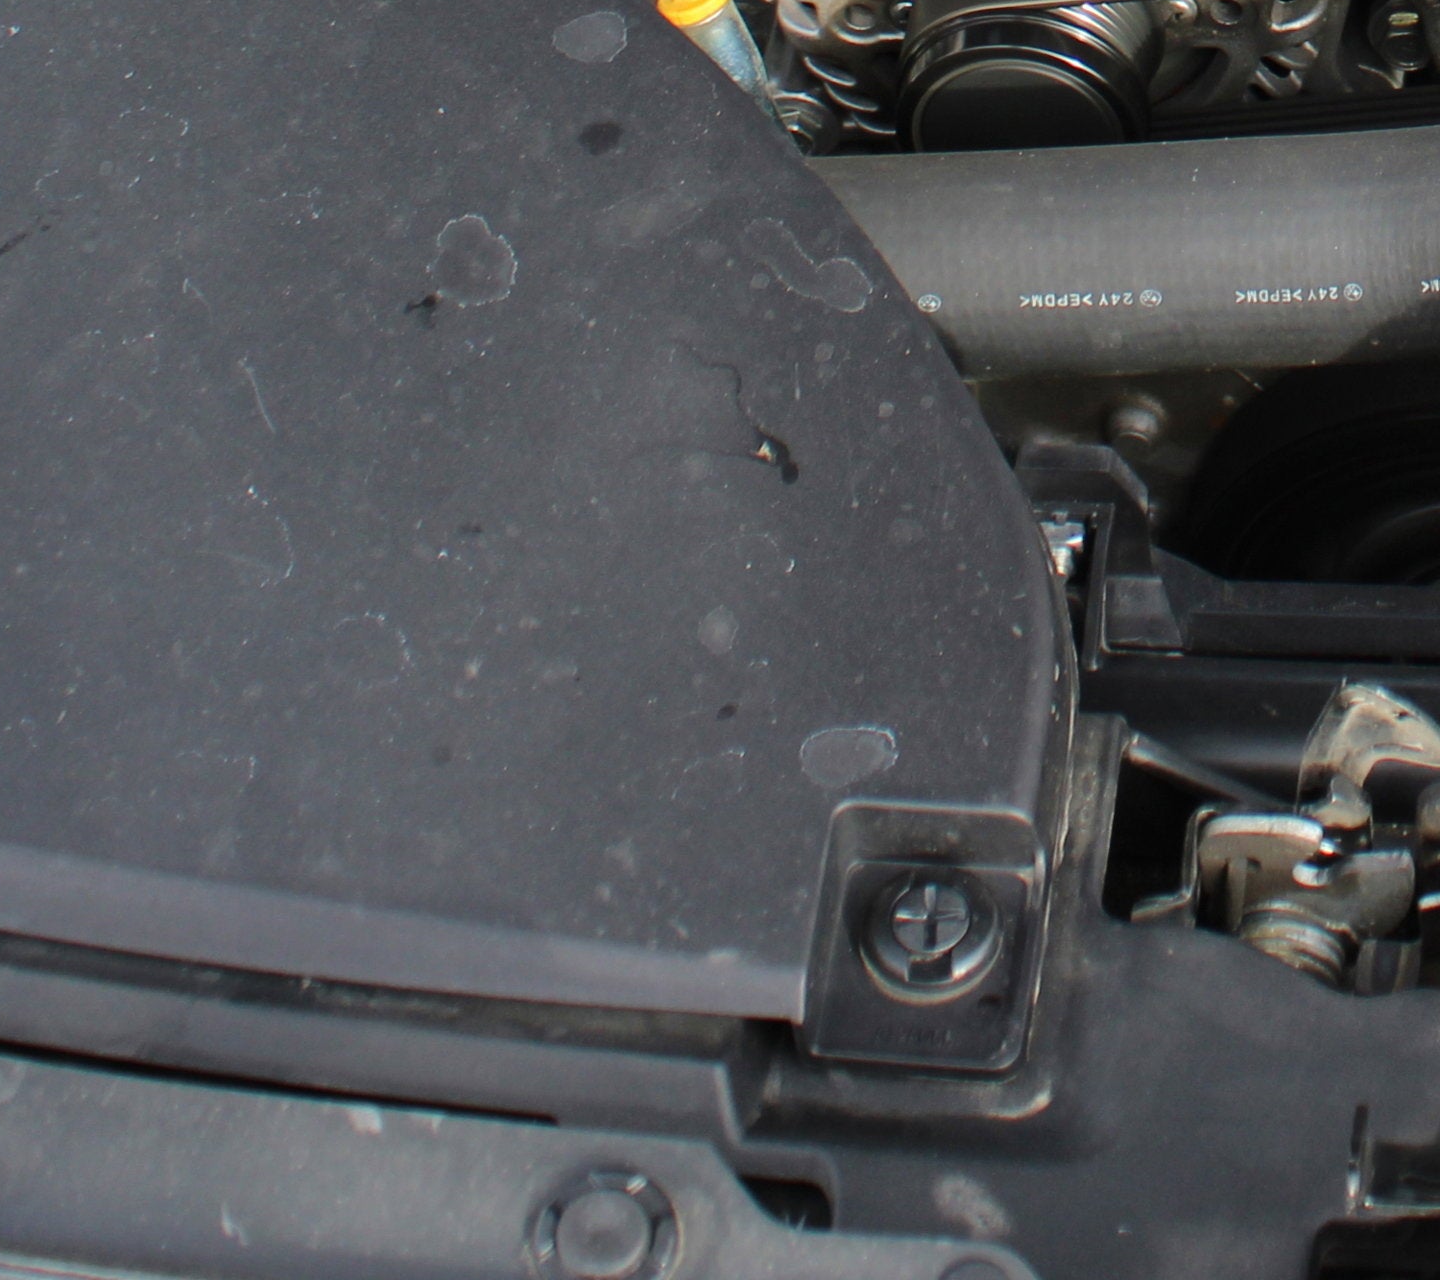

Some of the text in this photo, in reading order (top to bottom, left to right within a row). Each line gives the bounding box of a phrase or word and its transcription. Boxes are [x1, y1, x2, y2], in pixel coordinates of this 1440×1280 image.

[1019, 290, 1133, 308] 24Y >EPDM<
[1235, 285, 1339, 305] 24Y >EPDM<
